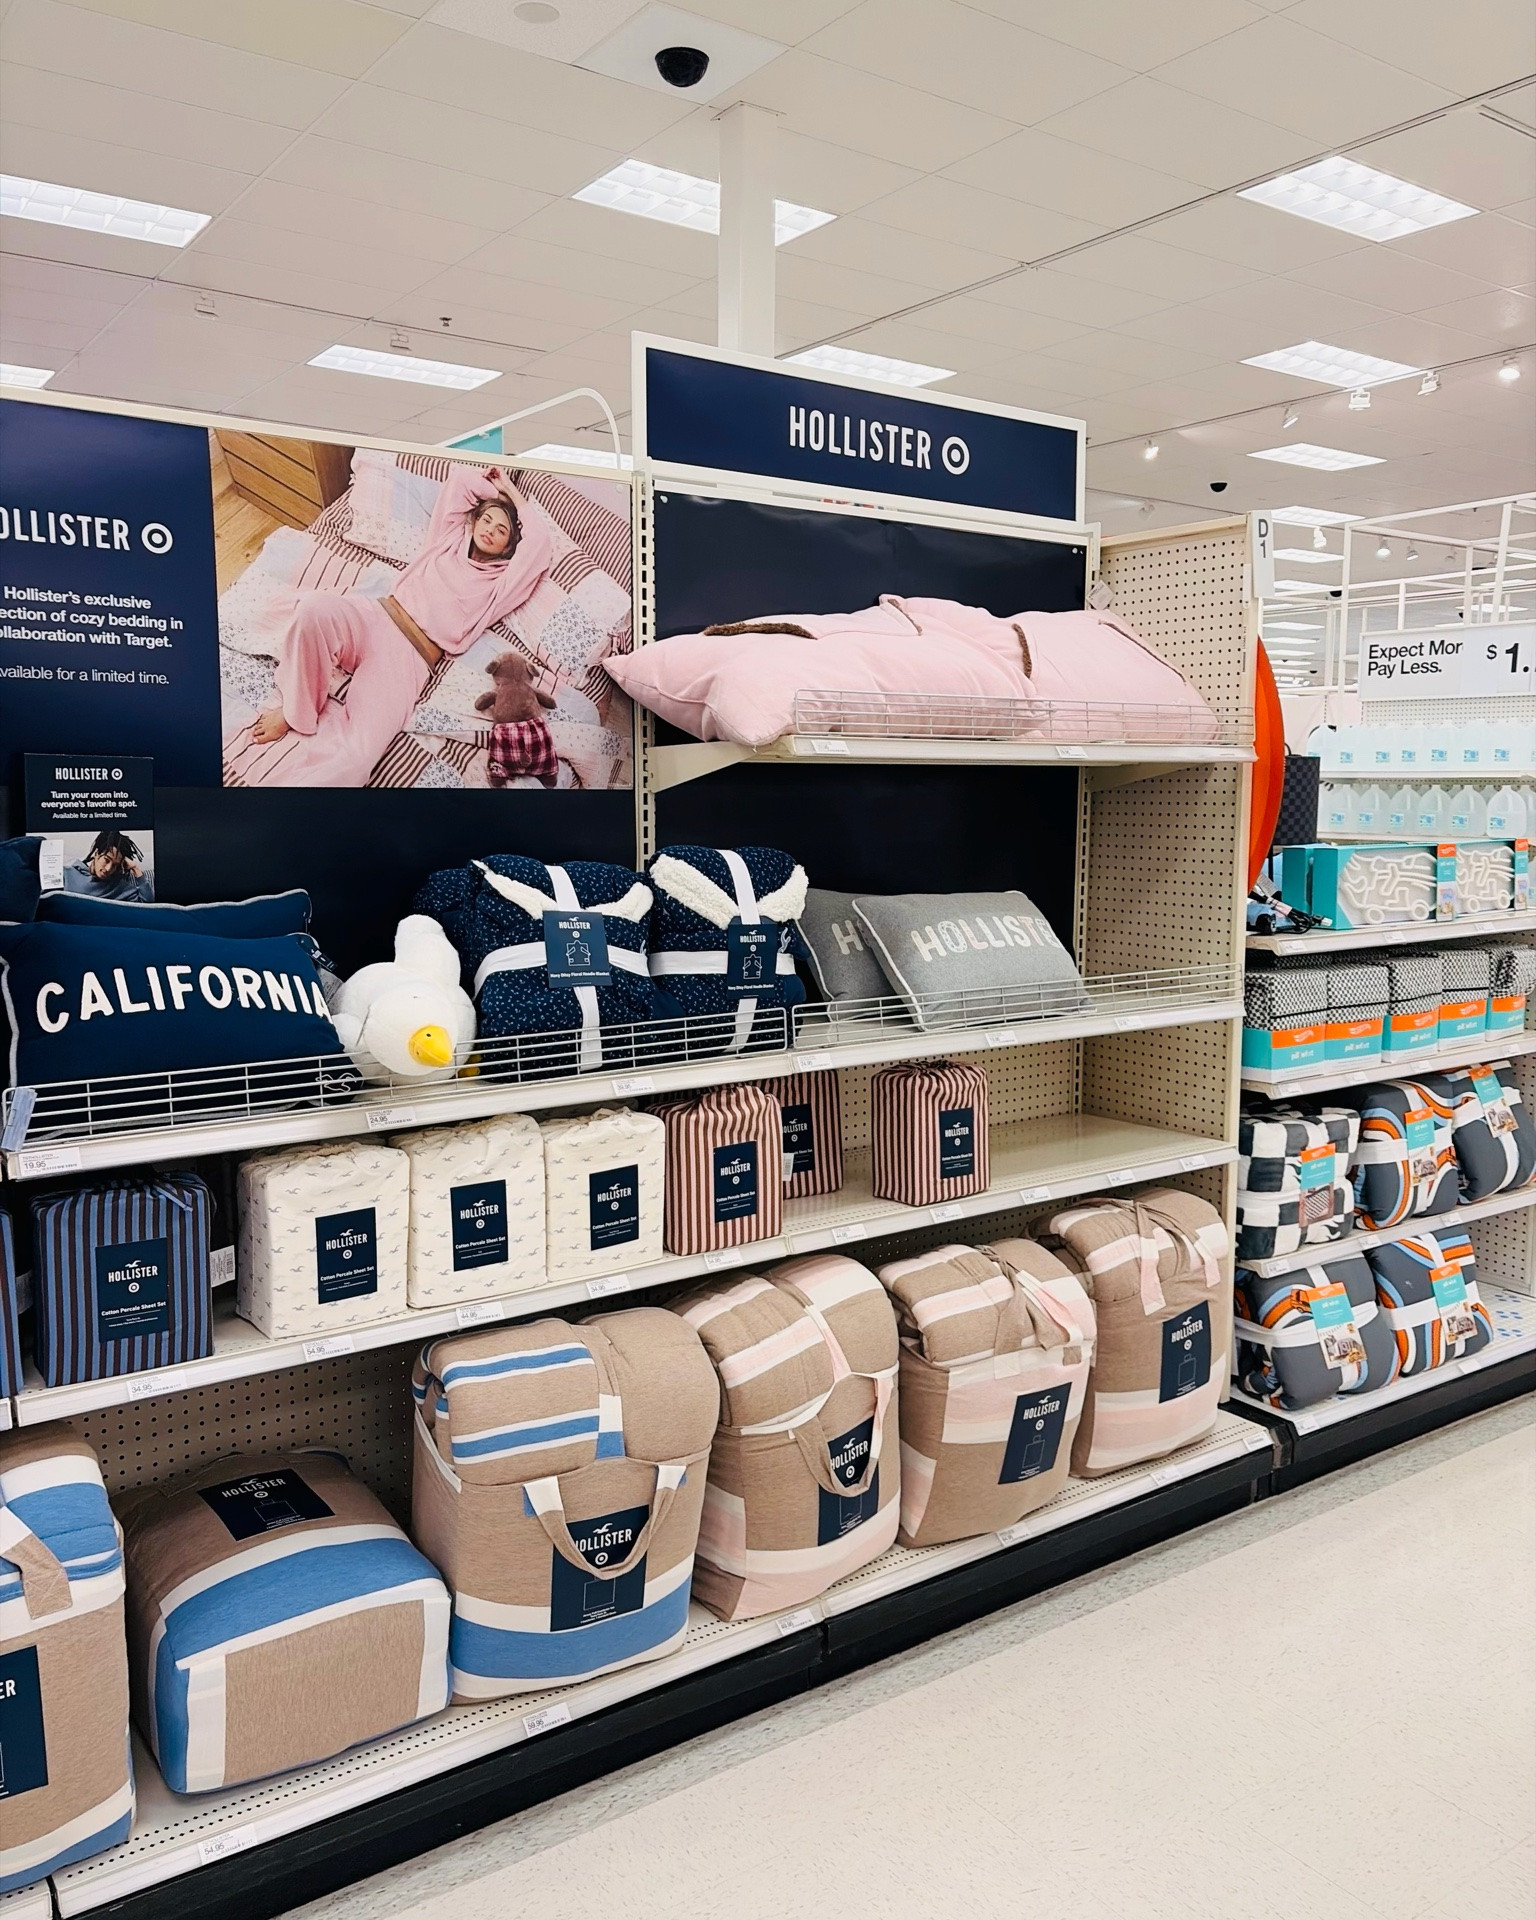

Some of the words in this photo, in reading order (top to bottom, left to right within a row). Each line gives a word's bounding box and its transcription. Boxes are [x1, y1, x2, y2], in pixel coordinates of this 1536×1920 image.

[789, 405, 931, 470] HOLLISTER
[1258, 518, 1269, 538] D
[1260, 540, 1266, 558] 1
[4, 585, 81, 605] Hollister's
[84, 594, 152, 609] exclusive
[0, 606, 47, 622] ection
[50, 610, 67, 622] of
[70, 613, 105, 627] cozy
[108, 613, 167, 631] bedding
[170, 616, 183, 629] in
[89, 631, 121, 645] with
[124, 632, 173, 649] Target.
[1368, 642, 1425, 661] Expect
[1428, 639, 1464, 656] Mor
[1486, 644, 1498, 660] $
[1505, 642, 1536, 673] 1.
[0, 665, 53, 680] vailable
[56, 667, 76, 681] for
[79, 671, 88, 681] a
[91, 669, 135, 683] limited
[138, 671, 170, 684] time.
[1368, 661, 1396, 679] Pay
[1400, 660, 1442, 675] Less.
[55, 768, 108, 780] HOLLISTER
[41, 800, 85, 809] everyone's
[87, 800, 116, 808] favorite
[118, 800, 137, 809] spot.
[50, 791, 69, 799] Turn
[71, 791, 89, 800] your
[113, 791, 129, 799] into
[559, 921, 591, 930] HOLLISTER
[740, 935, 767, 943] HOLLISTER
[910, 915, 1062, 962] HOLLISTE
[36, 965, 333, 1033] CALIFORNIA
[783, 1122, 808, 1134] OLLISTER
[944, 1126, 969, 1137] HOLLISTER
[24, 1161, 46, 1170] 19.95
[720, 1162, 751, 1177] HOLLISTER
[597, 1187, 632, 1203] HOLLISTER
[460, 1204, 499, 1219] HOLLISTER
[325, 1233, 368, 1251] HOLLISTER
[108, 1265, 158, 1283] HOLLISTER
[336, 1270, 353, 1278] Percale
[101, 1309, 119, 1317] Cotton
[141, 1302, 156, 1310] Sheet
[1171, 1320, 1203, 1343] HOLLISTER
[131, 1384, 152, 1393] 34.95
[1023, 1400, 1060, 1420] HOLLISTER
[830, 1440, 868, 1470] HOLLISTER
[221, 1478, 286, 1498] HOLLISTER
[528, 1719, 544, 1730] 59.95
[204, 1842, 225, 1855] 54.95
